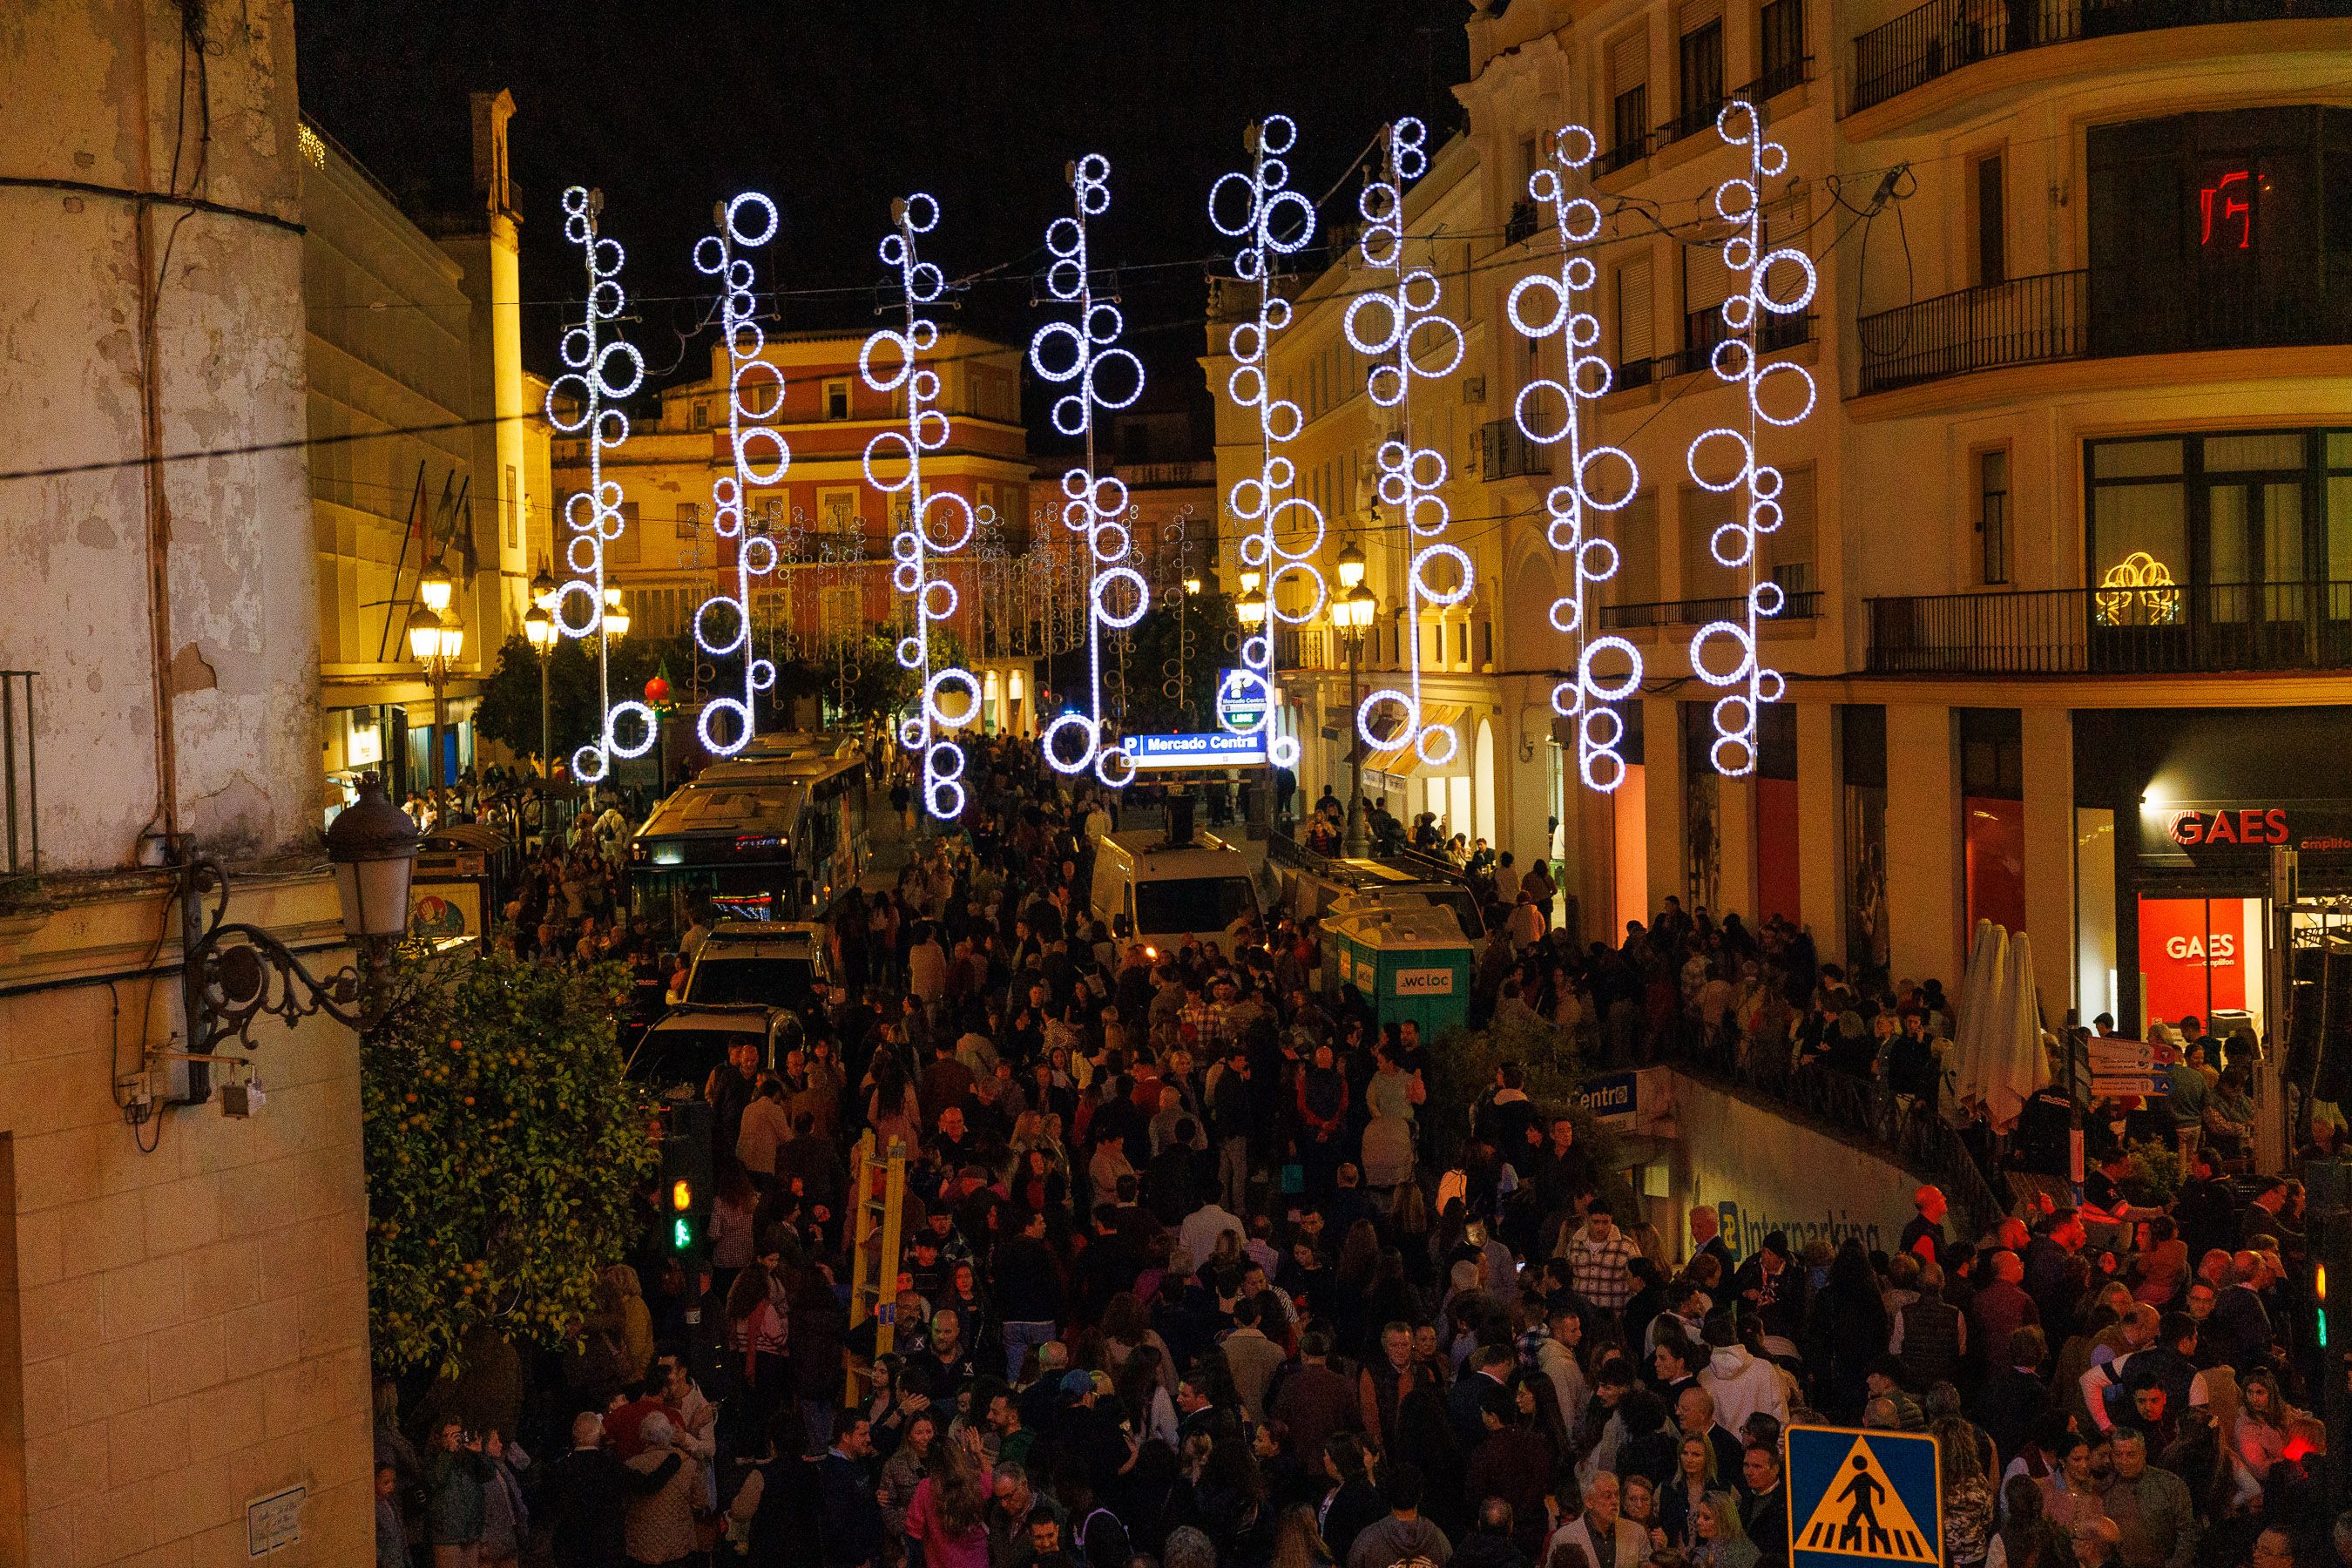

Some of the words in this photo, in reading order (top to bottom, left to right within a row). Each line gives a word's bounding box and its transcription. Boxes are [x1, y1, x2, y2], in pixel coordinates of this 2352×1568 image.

[1147, 737, 1207, 751] Mercado
[2168, 808, 2289, 845] GAES
[633, 851, 647, 861] 87
[2166, 934, 2234, 959] GAES
